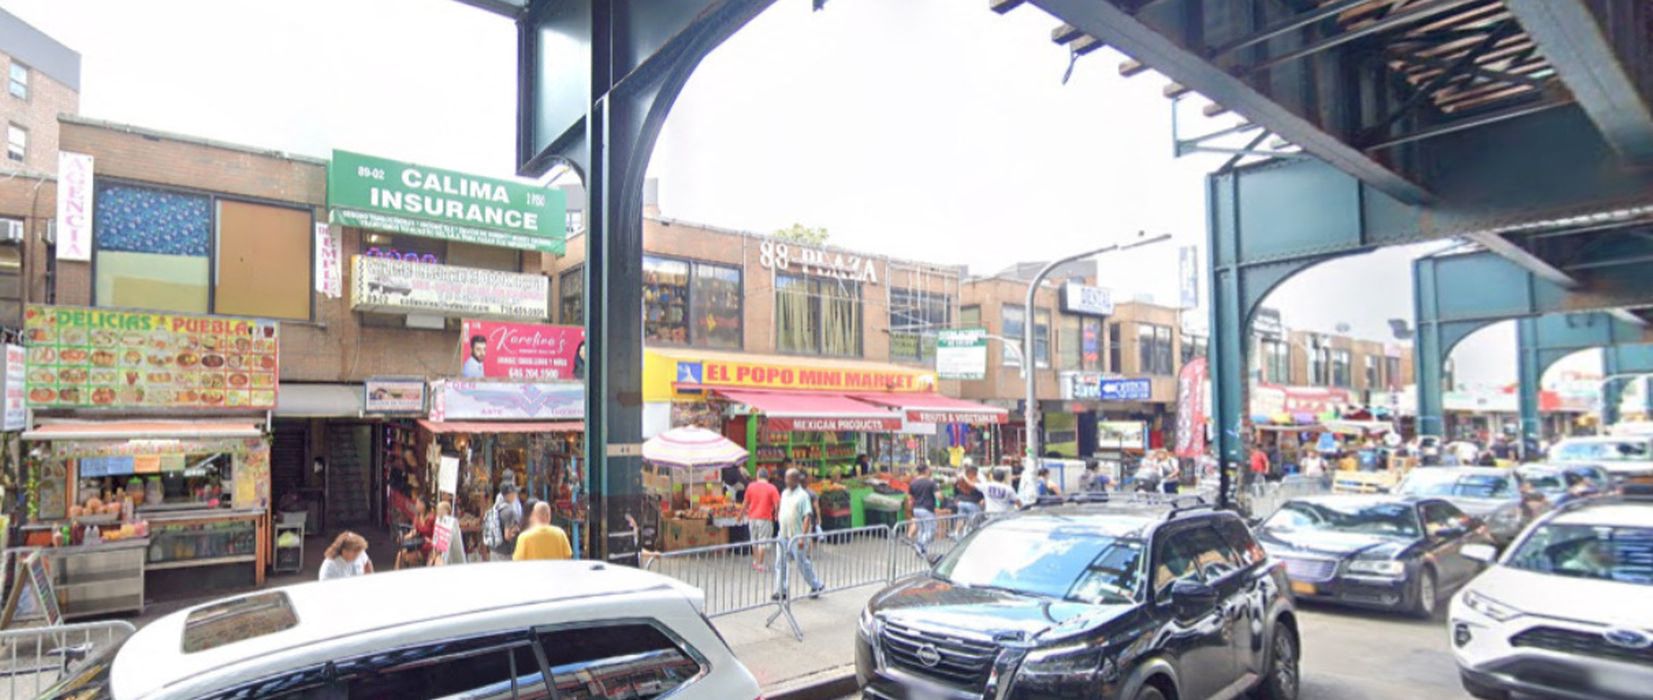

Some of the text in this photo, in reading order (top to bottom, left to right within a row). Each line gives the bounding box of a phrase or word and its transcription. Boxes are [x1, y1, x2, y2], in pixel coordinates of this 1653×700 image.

[357, 165, 385, 180] 89-02
[401, 168, 510, 203] CALIMA
[65, 156, 86, 257] AGENCIA
[370, 187, 538, 230] INSURANCE
[760, 239, 788, 270] 88
[801, 247, 877, 284] PLAZA
[55, 310, 151, 331] DELICIAS
[171, 316, 249, 337] PUEBLA
[706, 363, 914, 388] EL POPO MINI MARKET
[793, 419, 883, 430] MEXICAN PRODUCTS
